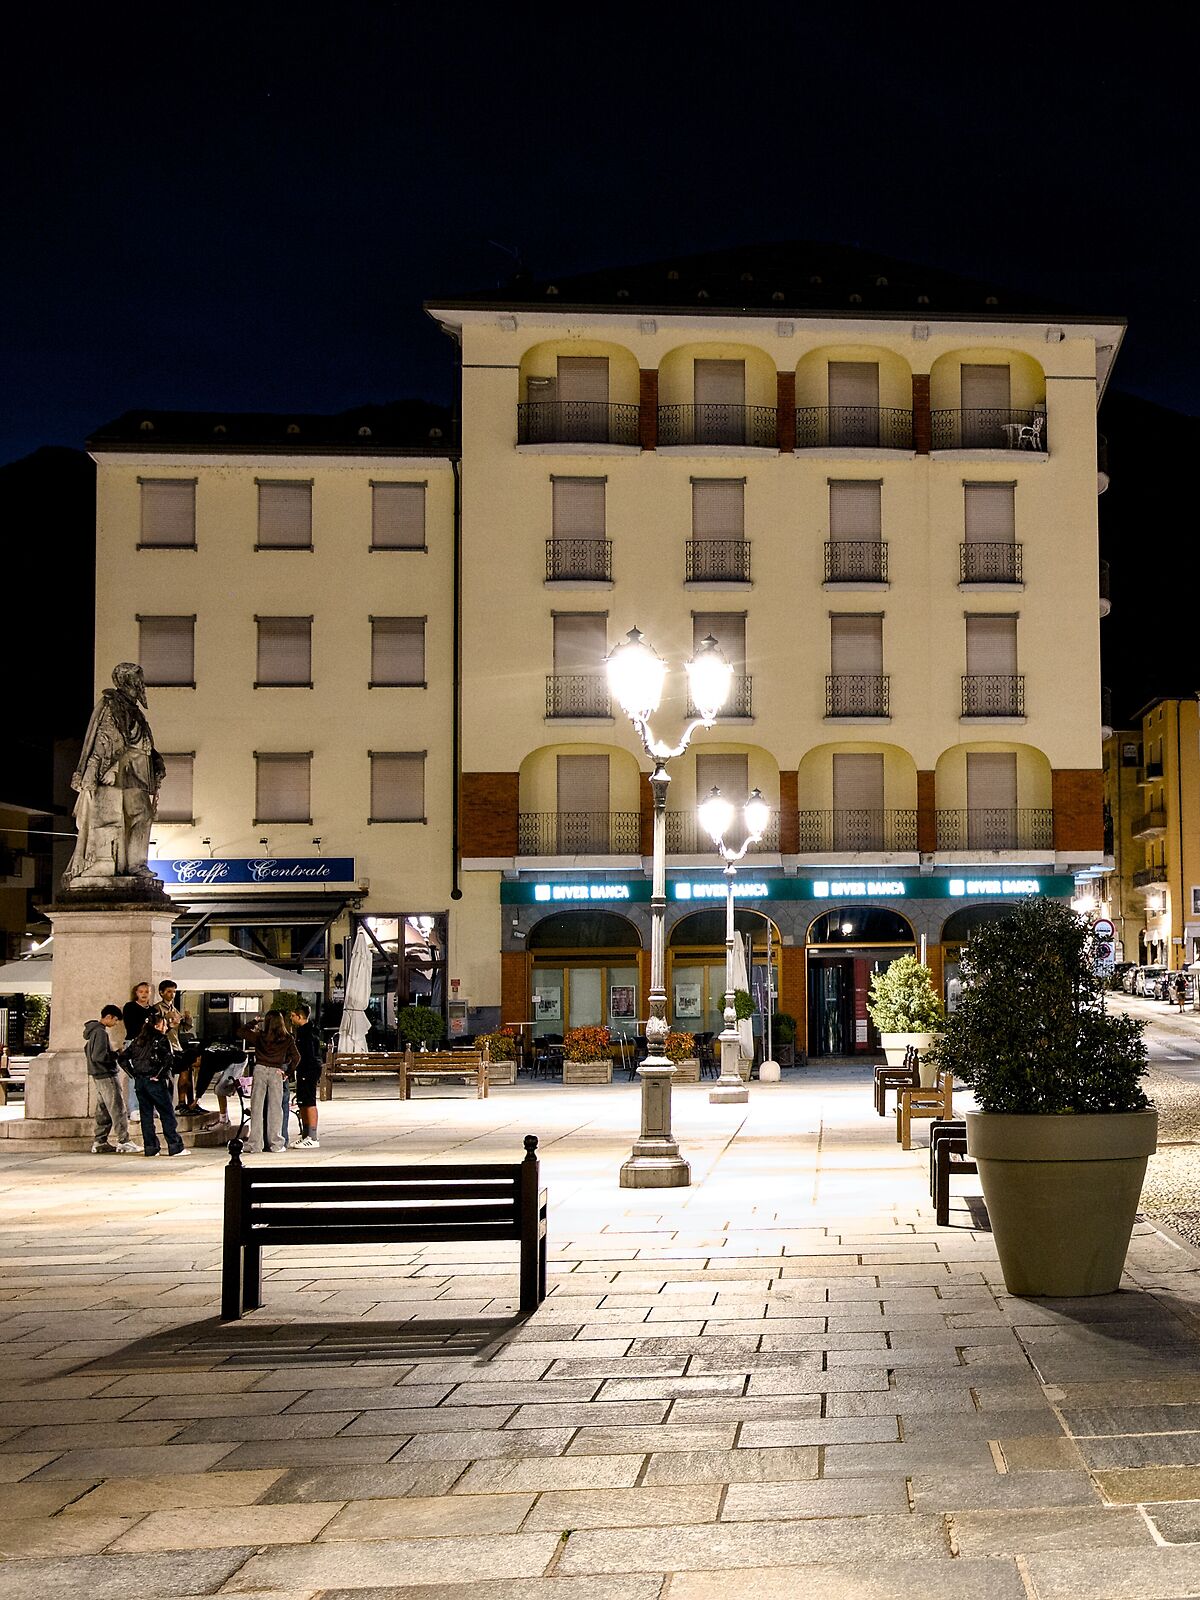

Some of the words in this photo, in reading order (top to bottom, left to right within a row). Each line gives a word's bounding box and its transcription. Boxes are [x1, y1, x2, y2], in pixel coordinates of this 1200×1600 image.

[172, 859, 230, 884] Caffè
[247, 859, 331, 882] Centrale
[590, 885, 630, 899] BANCA
[867, 881, 906, 895] BANCA
[1002, 880, 1040, 893] BANCA
